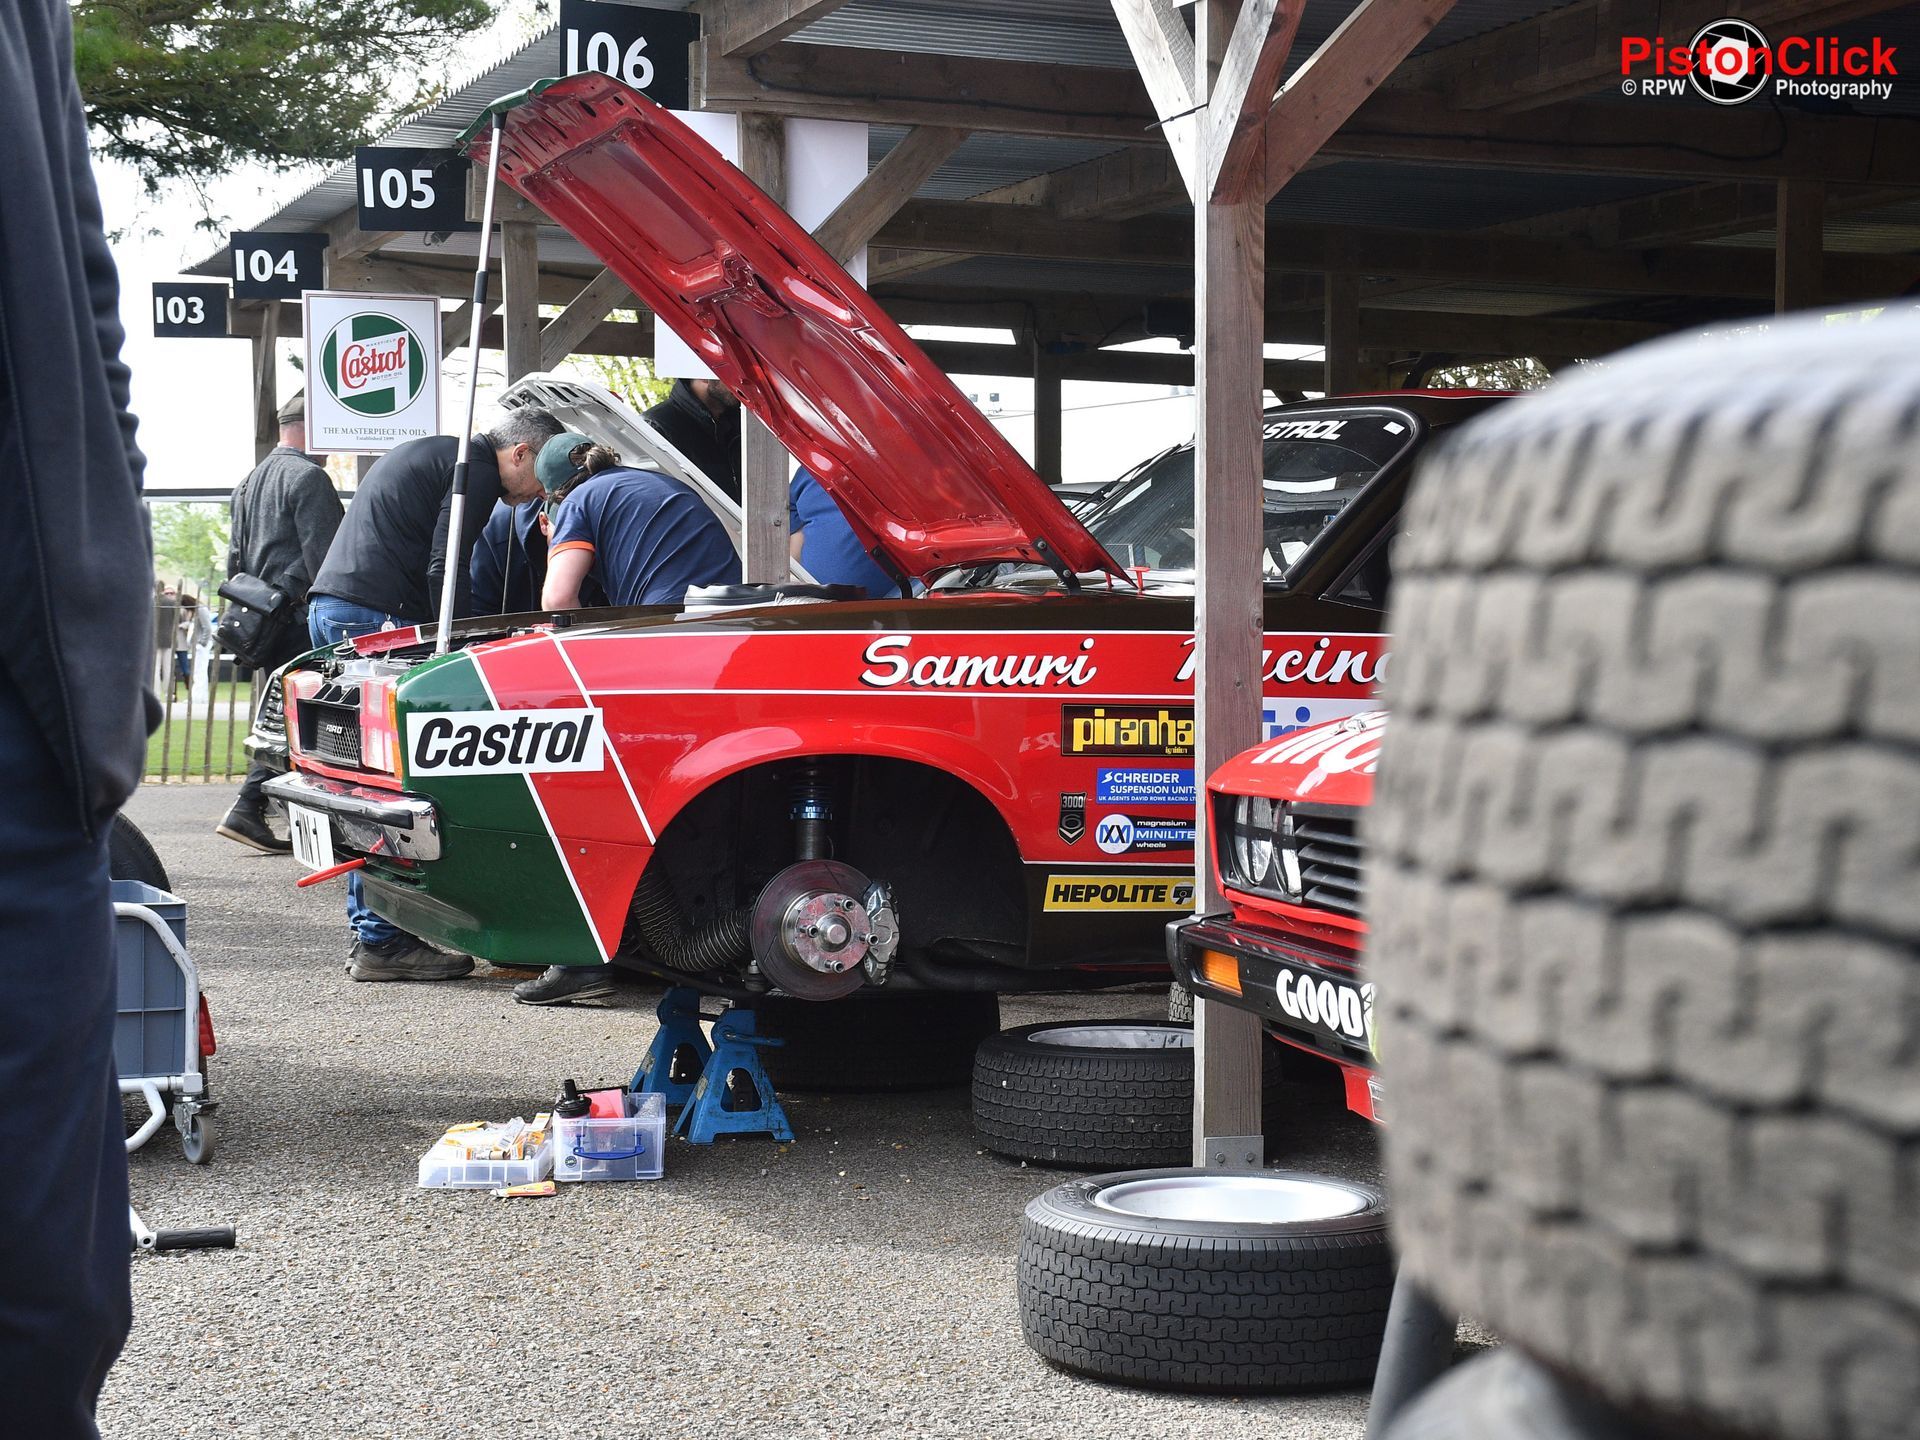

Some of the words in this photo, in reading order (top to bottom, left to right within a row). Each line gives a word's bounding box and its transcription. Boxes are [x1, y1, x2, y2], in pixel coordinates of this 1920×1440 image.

[567, 28, 654, 89] 106
[362, 168, 436, 209] 105
[235, 249, 298, 282] 104
[155, 296, 205, 325] 103
[341, 336, 406, 389] Castrol
[323, 427, 340, 435] THE
[341, 427, 397, 436] MASTERPIECE
[399, 428, 407, 436] IN
[409, 428, 427, 437] OILS
[1263, 420, 1348, 441] STROL
[859, 635, 1098, 688] Samuri
[414, 714, 595, 770] Castrol
[1072, 708, 1194, 752] piranha
[1062, 795, 1084, 808] 3000
[1110, 785, 1169, 794] SUSPENSION
[1136, 830, 1196, 840] MINILITE
[1137, 820, 1187, 828] magnesium
[1136, 841, 1167, 849] wheels
[1052, 884, 1168, 903] HEPOLITE
